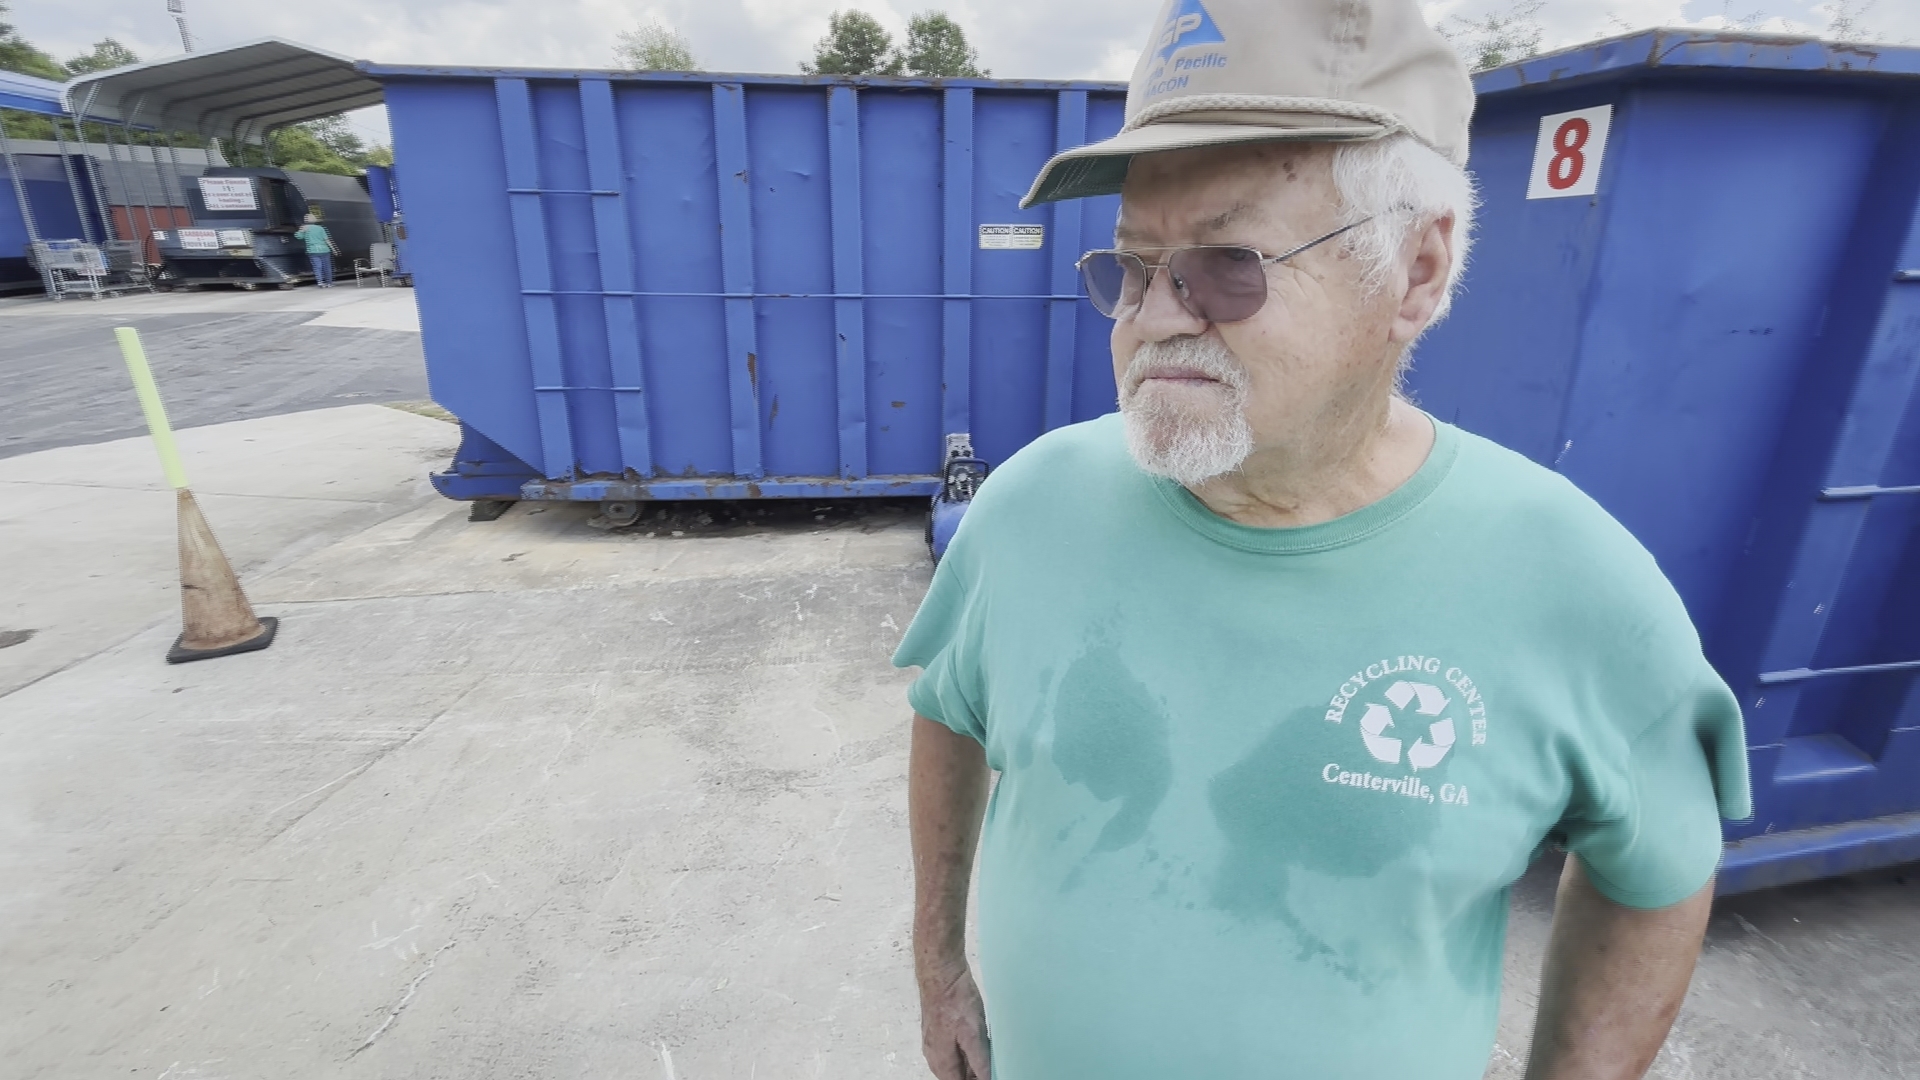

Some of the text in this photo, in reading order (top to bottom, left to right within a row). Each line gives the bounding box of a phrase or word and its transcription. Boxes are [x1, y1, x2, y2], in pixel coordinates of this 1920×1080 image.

[1174, 53, 1227, 72] Pacific
[1547, 117, 1592, 190] 8
[1324, 655, 1488, 746] RECYCLING CENTER
[1322, 763, 1470, 805] Centerville, GA
